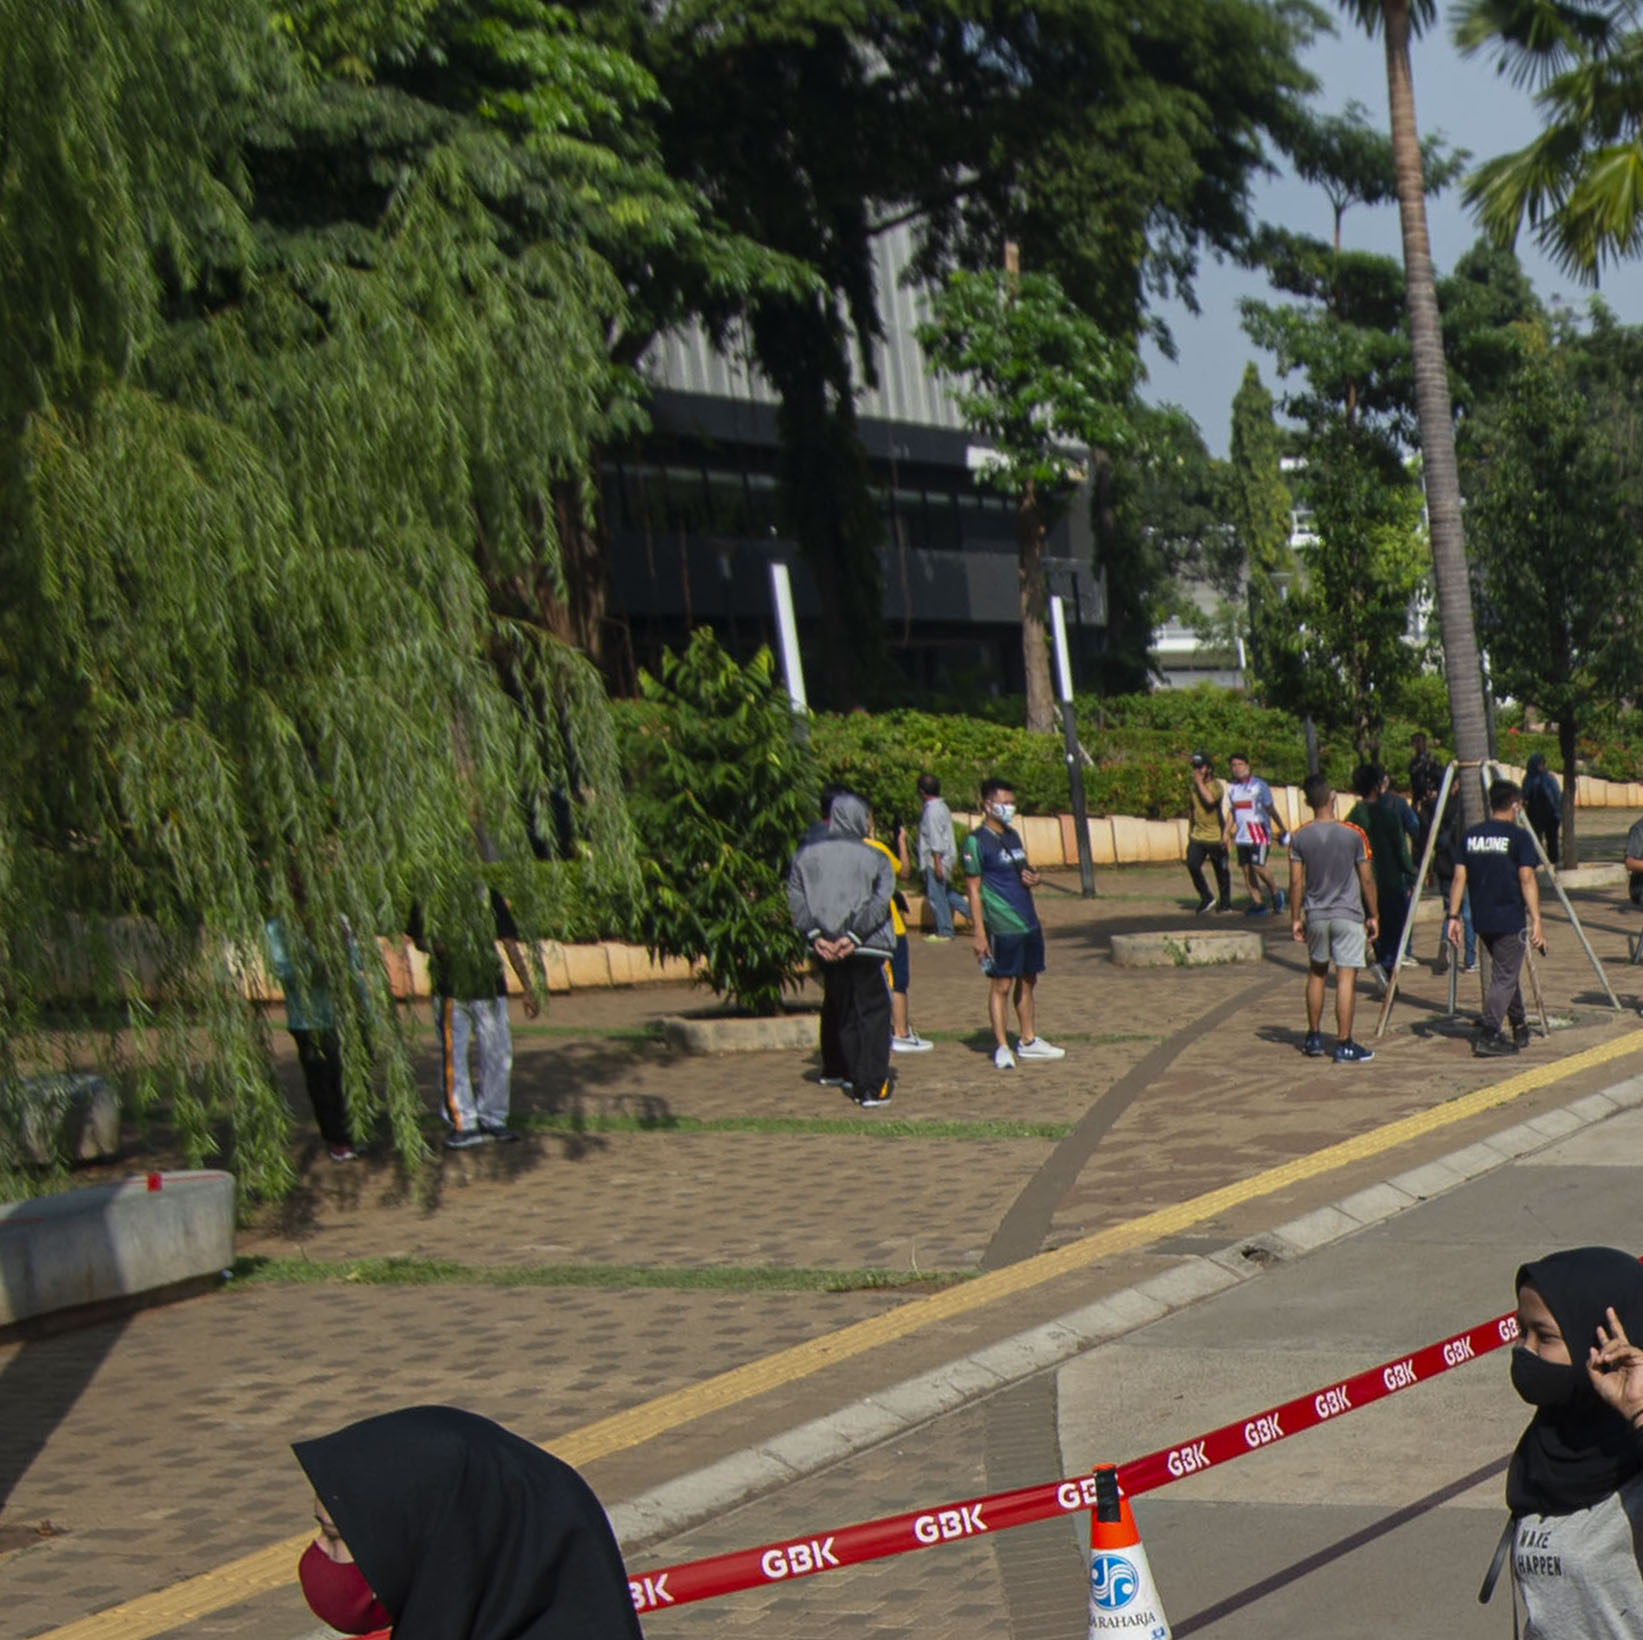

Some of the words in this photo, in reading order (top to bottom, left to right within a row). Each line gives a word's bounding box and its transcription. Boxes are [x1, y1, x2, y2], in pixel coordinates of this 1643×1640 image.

[629, 1573, 674, 1610] BK
[761, 1537, 839, 1579] GBK
[914, 1503, 988, 1544] GBK
[1167, 1441, 1210, 1476] GBK
[1244, 1413, 1284, 1448] GBK
[1315, 1386, 1352, 1419] GBK
[1383, 1360, 1418, 1391] GBK
[1443, 1336, 1475, 1366] GBK
[1498, 1316, 1519, 1342] GB
[1518, 1556, 1561, 1576] HAPPEN
[1098, 1612, 1156, 1628] RAHARJA
